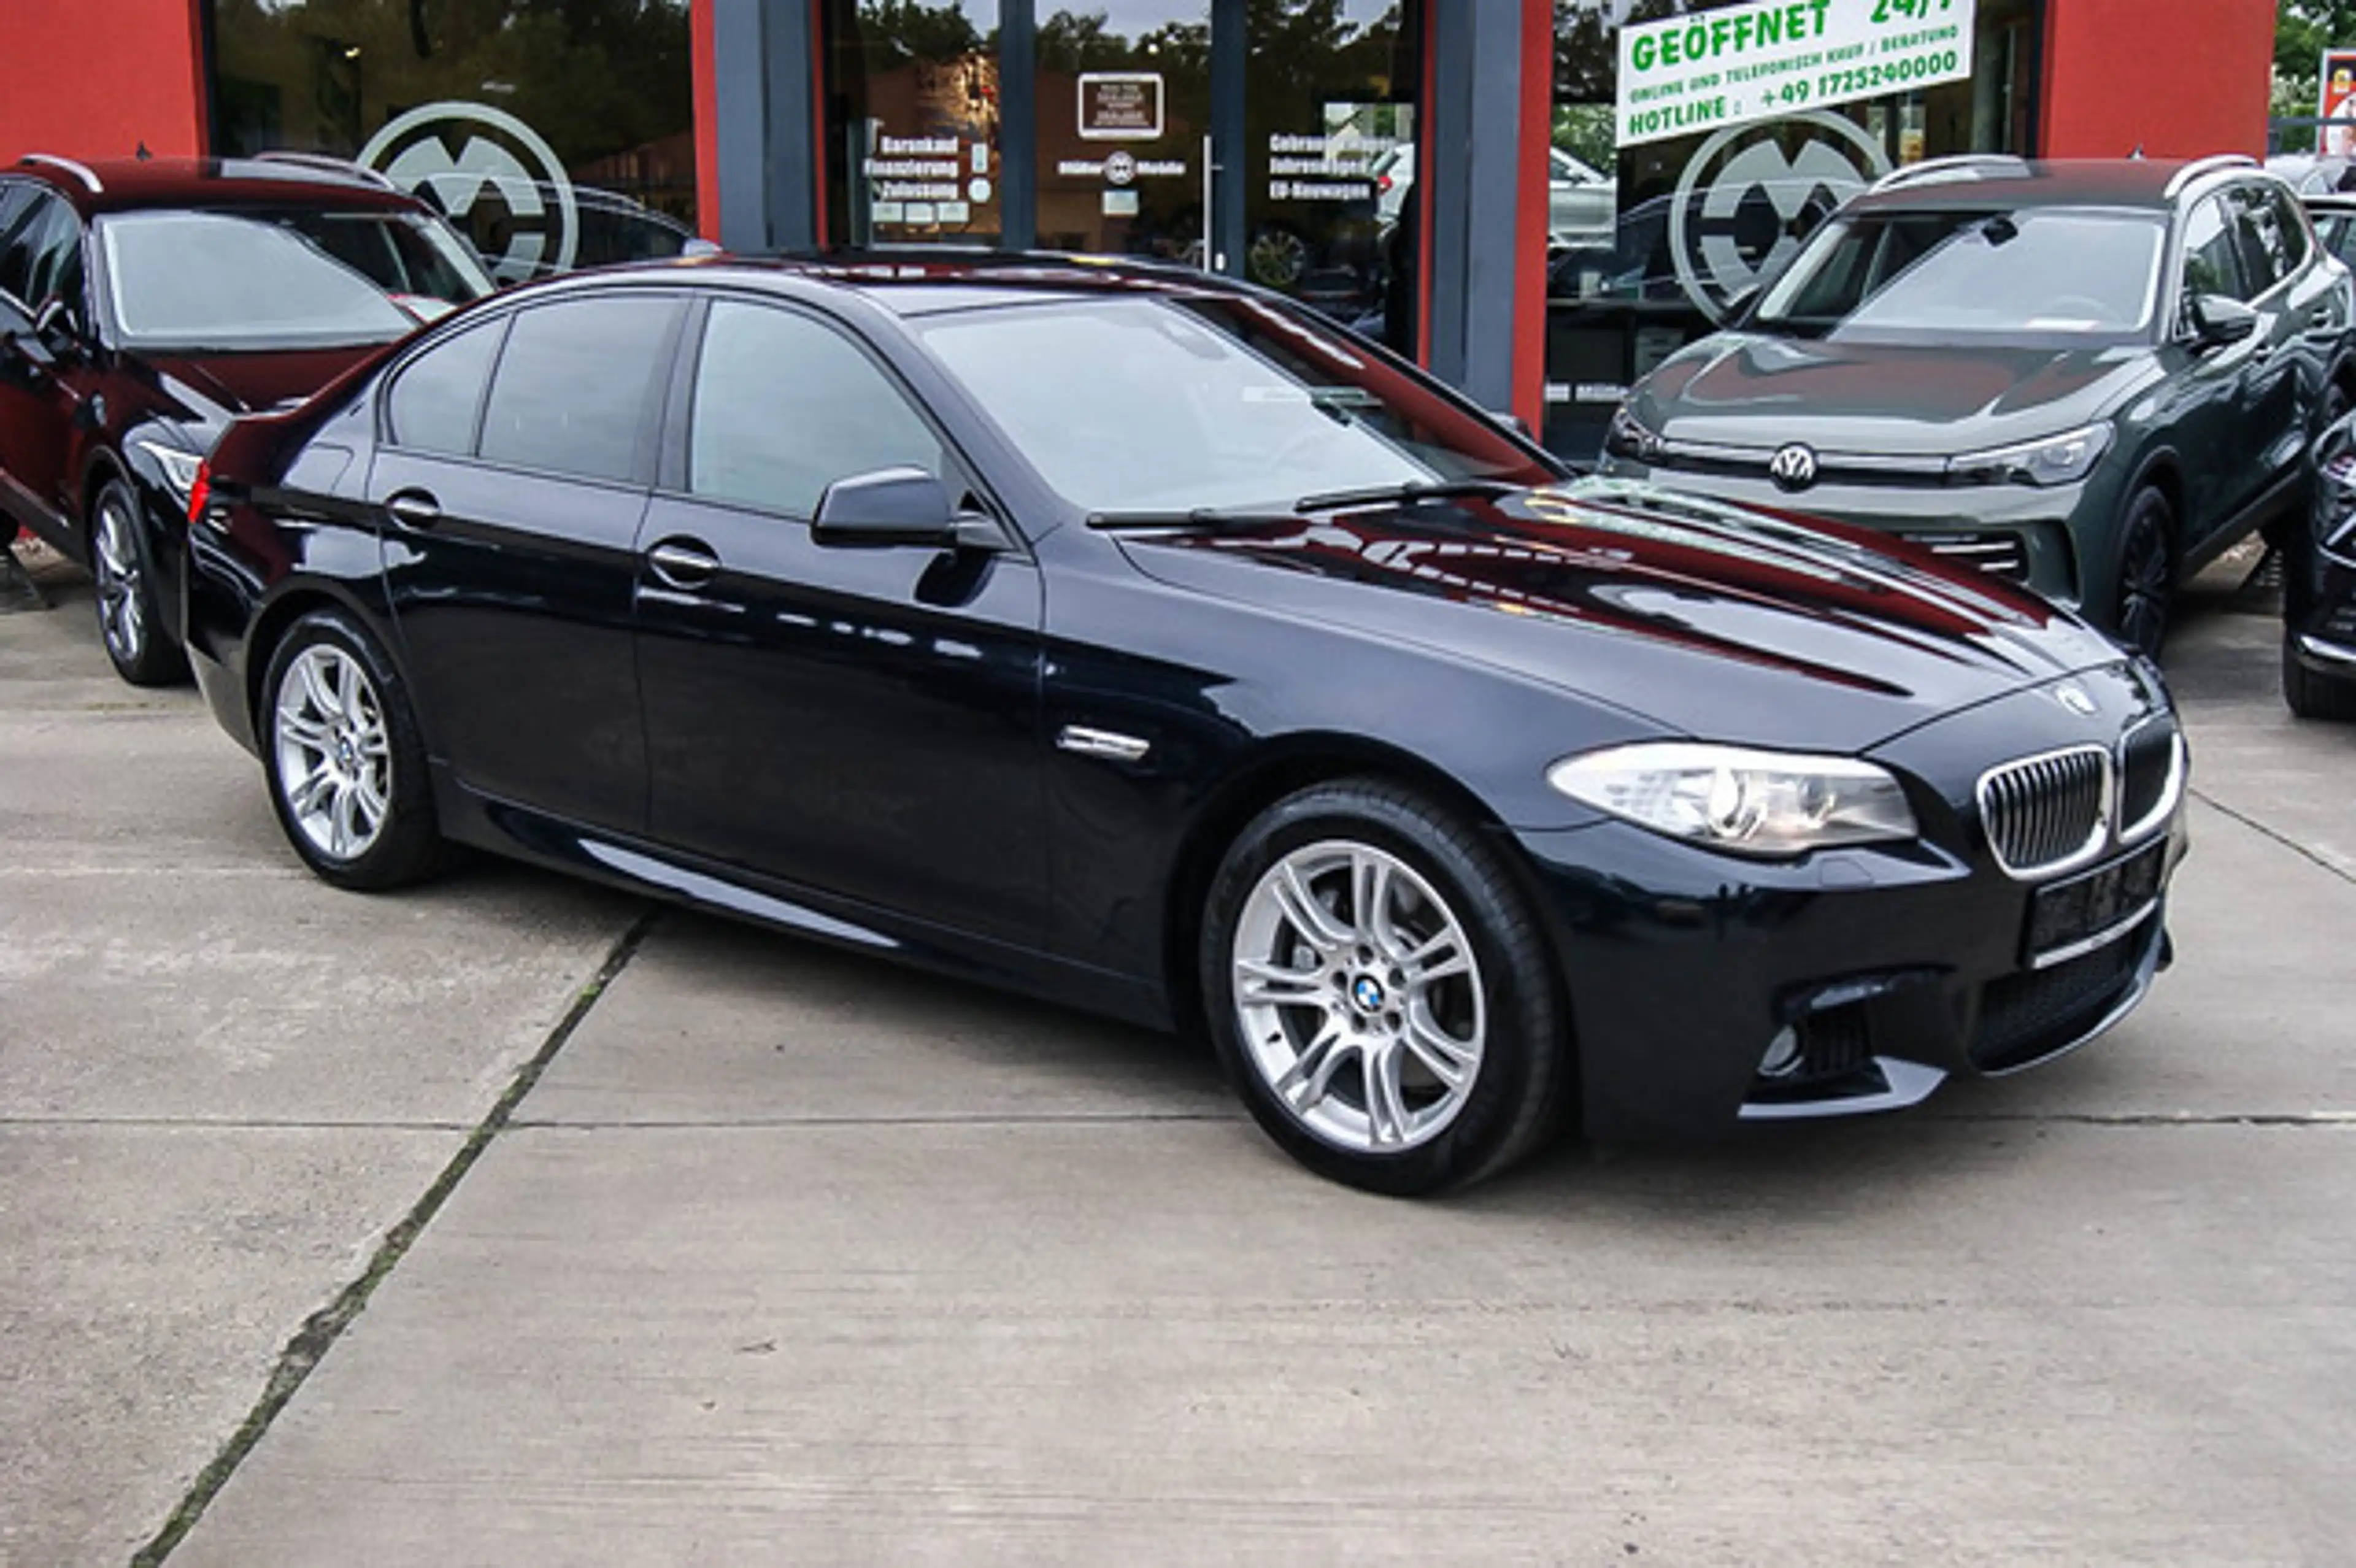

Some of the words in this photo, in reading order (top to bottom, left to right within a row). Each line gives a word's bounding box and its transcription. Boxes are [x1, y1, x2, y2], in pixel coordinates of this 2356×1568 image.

[1632, 0, 1830, 71] GEÖFFNET
[1630, 80, 1683, 104] ONLINE
[1690, 73, 1720, 91] UND
[1727, 52, 1822, 83] TELEFONISCH
[1880, 23, 1958, 52] BERATUNG
[1269, 134, 1398, 153] Gebrauwagen
[1629, 96, 1726, 136] HOTLINE
